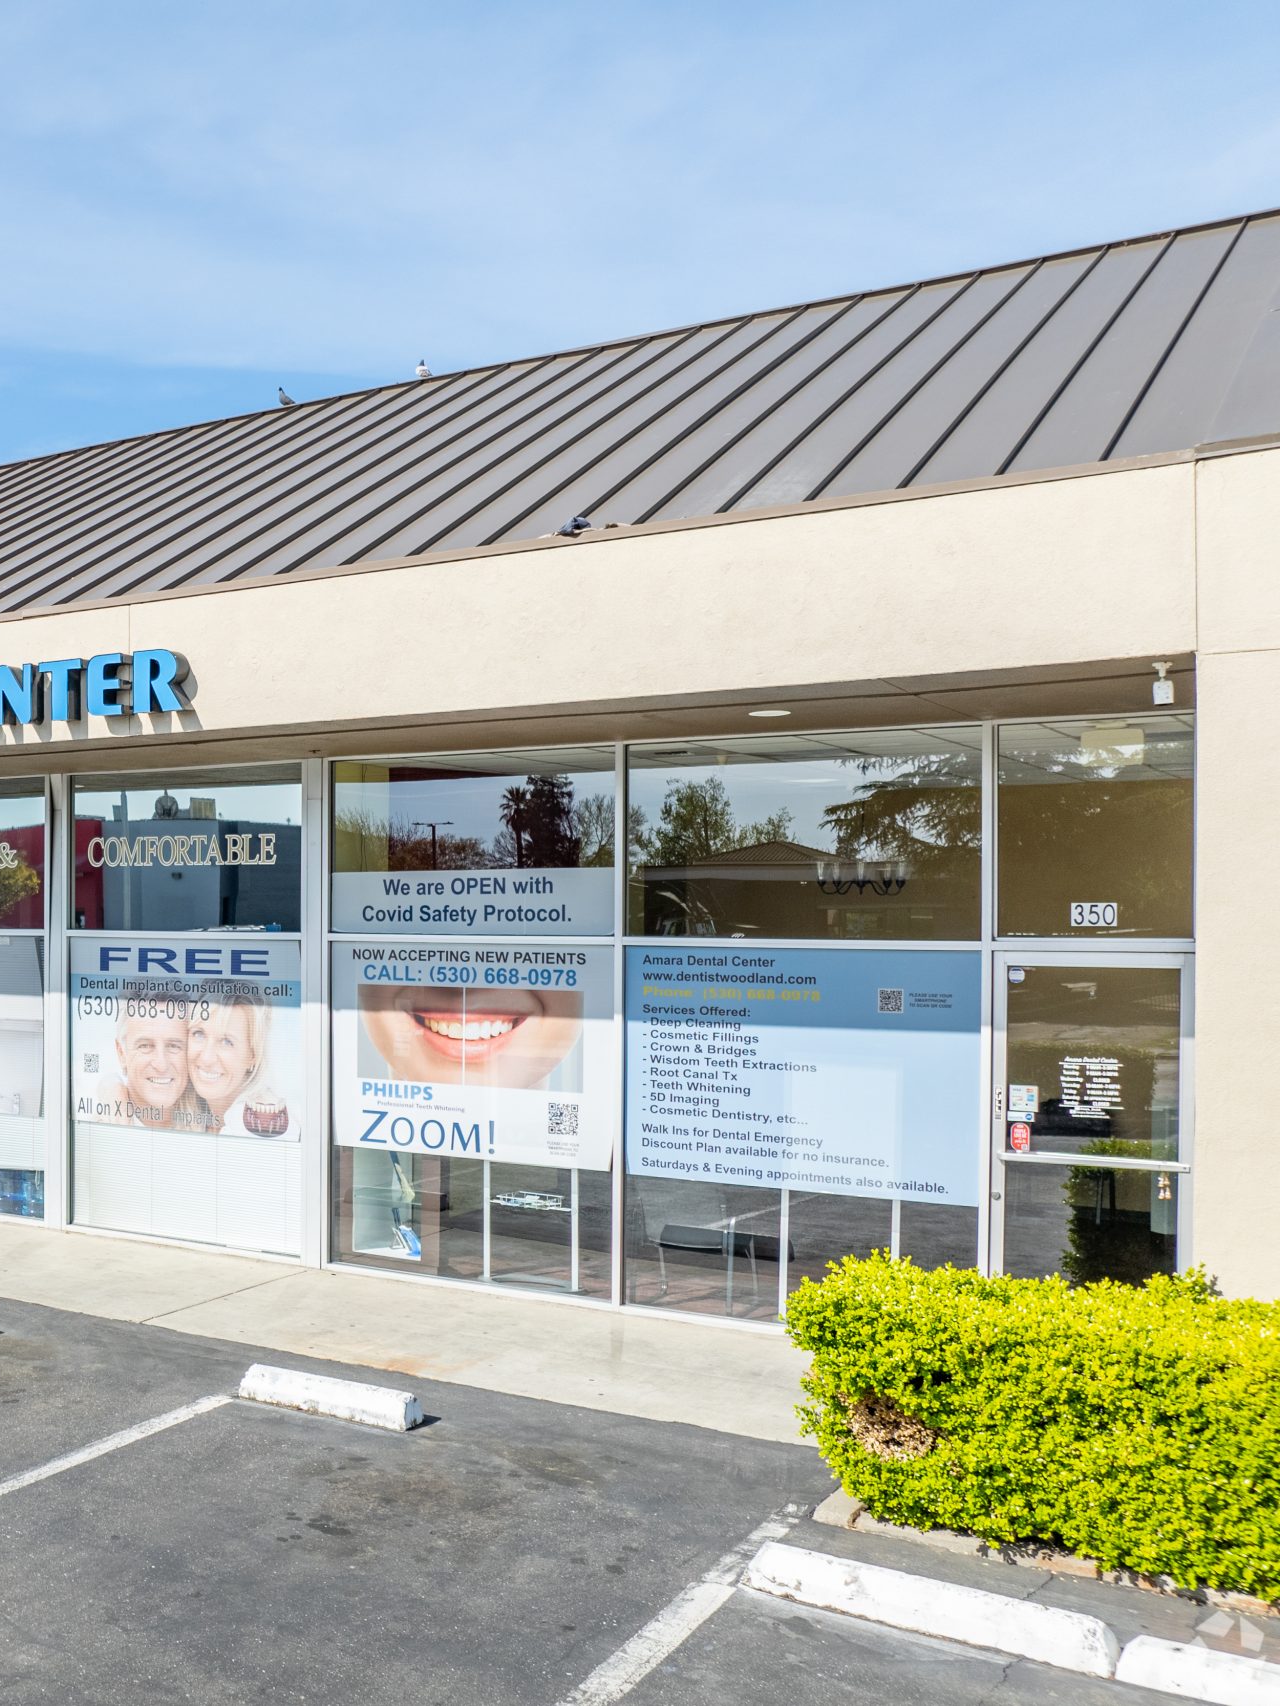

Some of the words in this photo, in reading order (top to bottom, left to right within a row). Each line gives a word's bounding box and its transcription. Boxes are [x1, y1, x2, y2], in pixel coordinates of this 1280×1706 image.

[87, 833, 277, 868] COMFORTABLE
[383, 879, 411, 896] We
[416, 881, 445, 896] are
[450, 877, 506, 895] OPEN
[512, 876, 554, 895] with
[362, 906, 413, 923] Covid
[420, 905, 477, 926] Safety
[484, 904, 572, 923] Protocol.
[1074, 904, 1115, 925] 350
[100, 946, 270, 977] FREE
[352, 948, 387, 960] NOW
[388, 949, 471, 963] ACCEPTING
[475, 951, 509, 964] NEW
[514, 952, 587, 965] PATIENTS
[642, 954, 683, 966] Amara
[688, 956, 727, 967] Dental
[732, 956, 776, 968] Center
[364, 964, 422, 982] CALL:
[430, 966, 478, 984] (530)
[484, 968, 577, 987] 668-0978
[642, 972, 817, 985] www.dentistwoodland.com
[80, 977, 119, 991] Dental
[122, 978, 170, 994] Implant
[174, 980, 259, 996] Consultation
[264, 984, 293, 997] call:
[78, 994, 120, 1022] (530)
[126, 997, 210, 1021] 668-0978
[642, 1004, 695, 1015] Services
[700, 1006, 751, 1017] Offered:
[650, 1017, 682, 1029] Deep
[686, 1018, 741, 1031] Cleaning
[650, 1030, 709, 1041] Cosmetic
[712, 1032, 759, 1045] Fillings
[650, 1042, 690, 1053] Crown
[694, 1044, 703, 1054] &
[708, 1045, 757, 1058] Bridges
[650, 1054, 700, 1066] Wisdom
[704, 1057, 738, 1068] Teeth
[742, 1060, 817, 1073] Extractions
[650, 1067, 679, 1078] Root
[683, 1068, 718, 1080] Canal
[722, 1071, 738, 1081] Tx
[362, 1081, 433, 1101] PHILIPS
[650, 1080, 683, 1090] Teeth
[686, 1082, 751, 1098] Whitening
[78, 1097, 93, 1114] All
[96, 1102, 111, 1116] on
[114, 1100, 122, 1117] X
[126, 1102, 164, 1121] Dental
[377, 1100, 414, 1109] Professional
[434, 1104, 465, 1113] Whitening
[650, 1092, 666, 1102] 5D
[670, 1094, 720, 1108] Imaging
[650, 1104, 708, 1118] Cosmetic
[712, 1109, 773, 1125] Dentistry,
[360, 1110, 495, 1155] ZOOM!
[642, 1124, 669, 1134] Walk
[672, 1126, 689, 1136] Ins
[692, 1127, 710, 1138] for
[712, 1128, 750, 1141] Dental
[754, 1132, 823, 1149] Emergency
[642, 1138, 693, 1151] Discount
[696, 1142, 722, 1153] Plan
[725, 1146, 778, 1158] available
[782, 1149, 799, 1160] for
[803, 1152, 819, 1162] no
[822, 1152, 889, 1168] insurance.
[642, 1157, 699, 1173] Saturdays
[702, 1162, 711, 1172] &
[715, 1164, 763, 1180] Evening
[766, 1170, 852, 1186] appointments
[856, 1176, 883, 1188] also
[886, 1181, 949, 1194] available.
